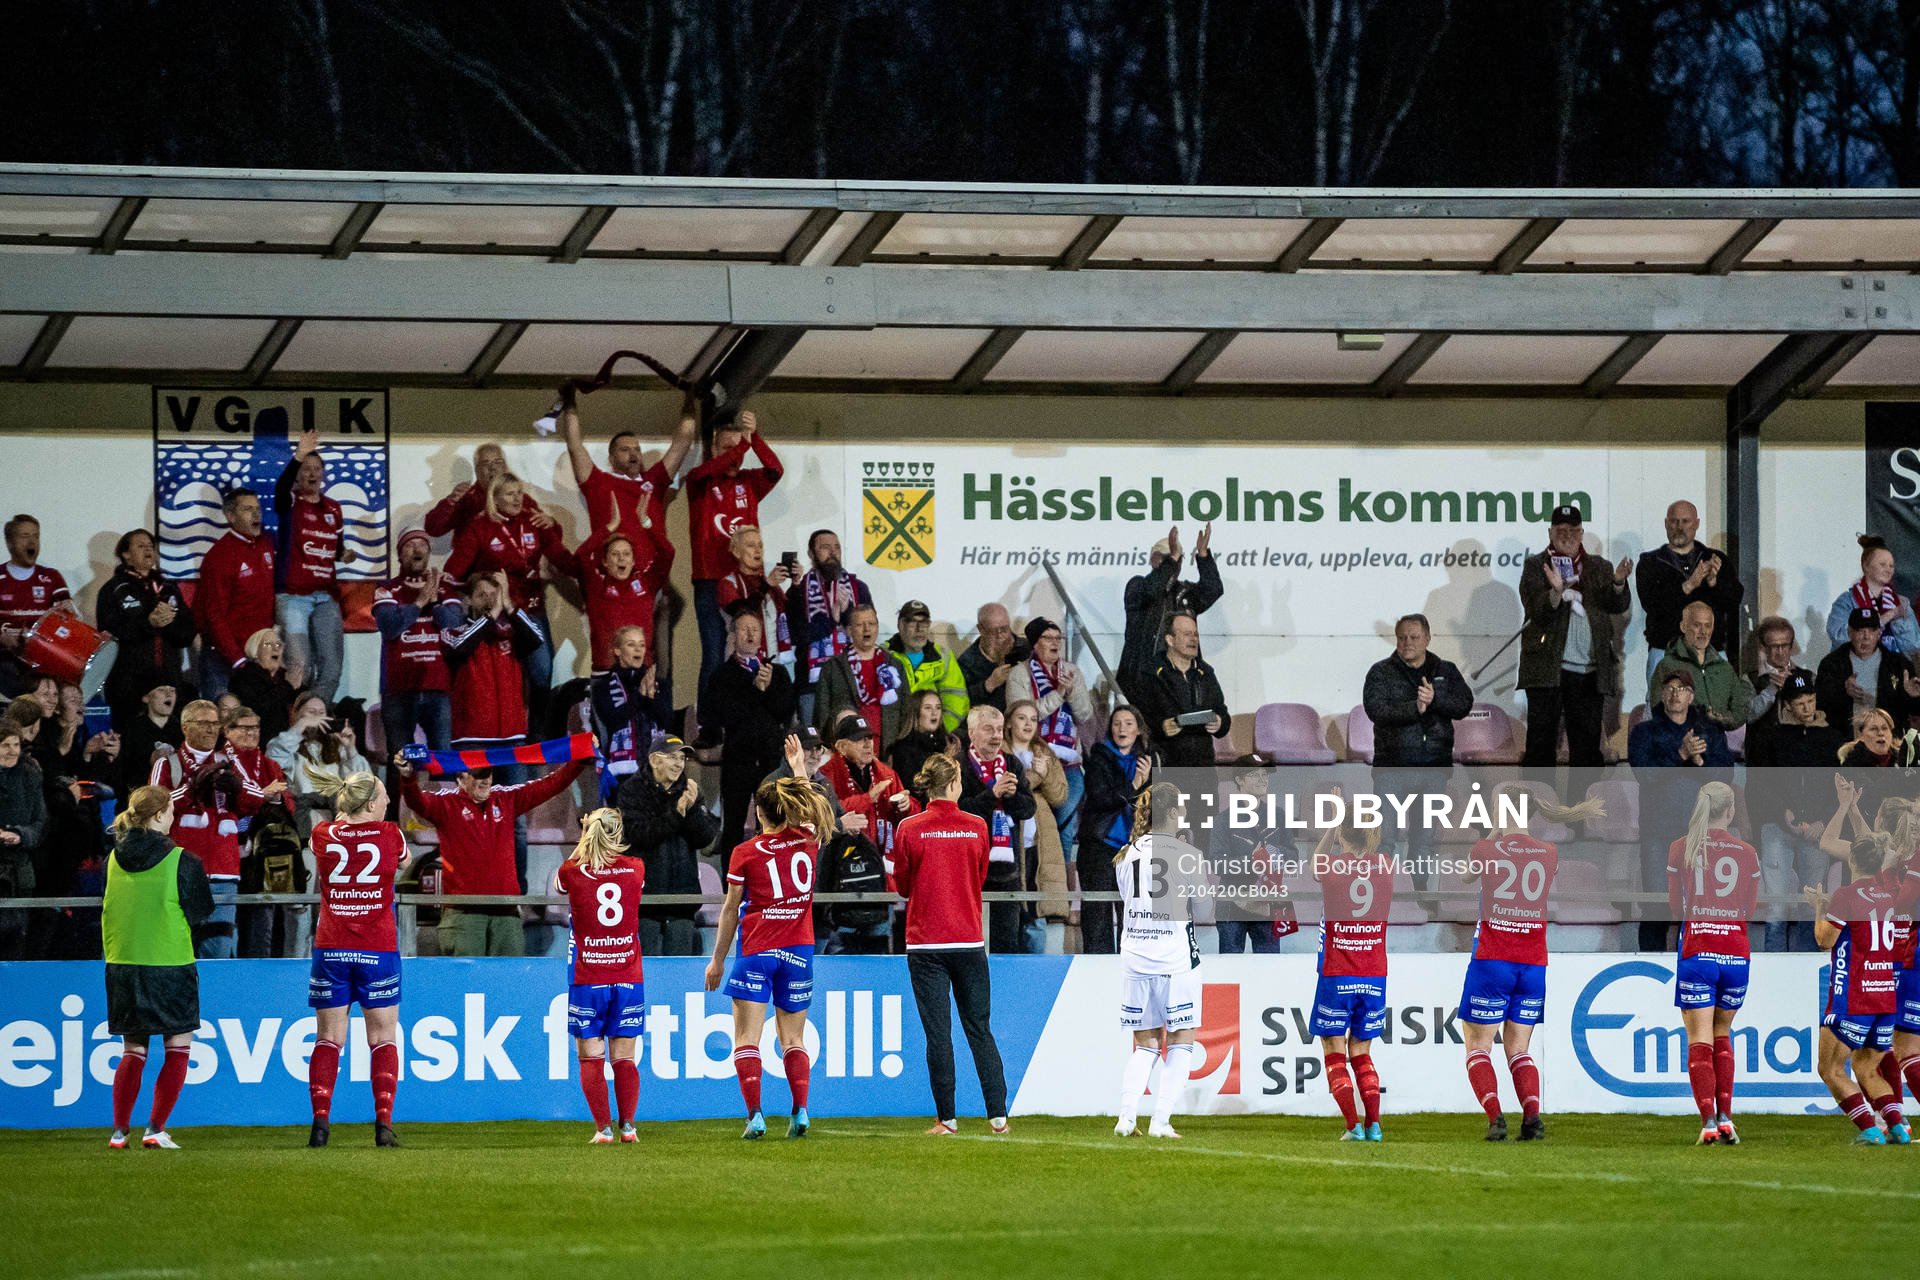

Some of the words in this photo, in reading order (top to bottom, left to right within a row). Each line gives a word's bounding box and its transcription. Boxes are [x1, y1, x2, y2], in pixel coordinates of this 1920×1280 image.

[963, 473, 1325, 522] Hässleholms
[1338, 478, 1592, 523] kommun
[960, 546, 1001, 566] Här
[1006, 546, 1060, 566] möts
[1066, 546, 1151, 566] männis
[1189, 546, 1221, 567] fr
[1226, 549, 1258, 567] att
[1263, 548, 1313, 570] leva,
[1320, 548, 1412, 572] uppleva,
[1419, 549, 1491, 568] arbeta
[325, 842, 381, 884] 22
[765, 850, 813, 900] 10
[1131, 858, 1169, 899] 13
[1493, 859, 1546, 901] 20
[1694, 854, 1739, 898] 19
[329, 888, 383, 899] furninova
[596, 882, 624, 926] 8
[1349, 876, 1374, 917] 9
[1492, 904, 1541, 918] furninova
[584, 932, 634, 947] furninova
[1333, 922, 1382, 934] furninova
[1868, 907, 1895, 952] 16
[543, 990, 904, 1080] ftboll!
[1261, 1006, 1503, 1046] SVSK
[1261, 1056, 1387, 1096] SP
